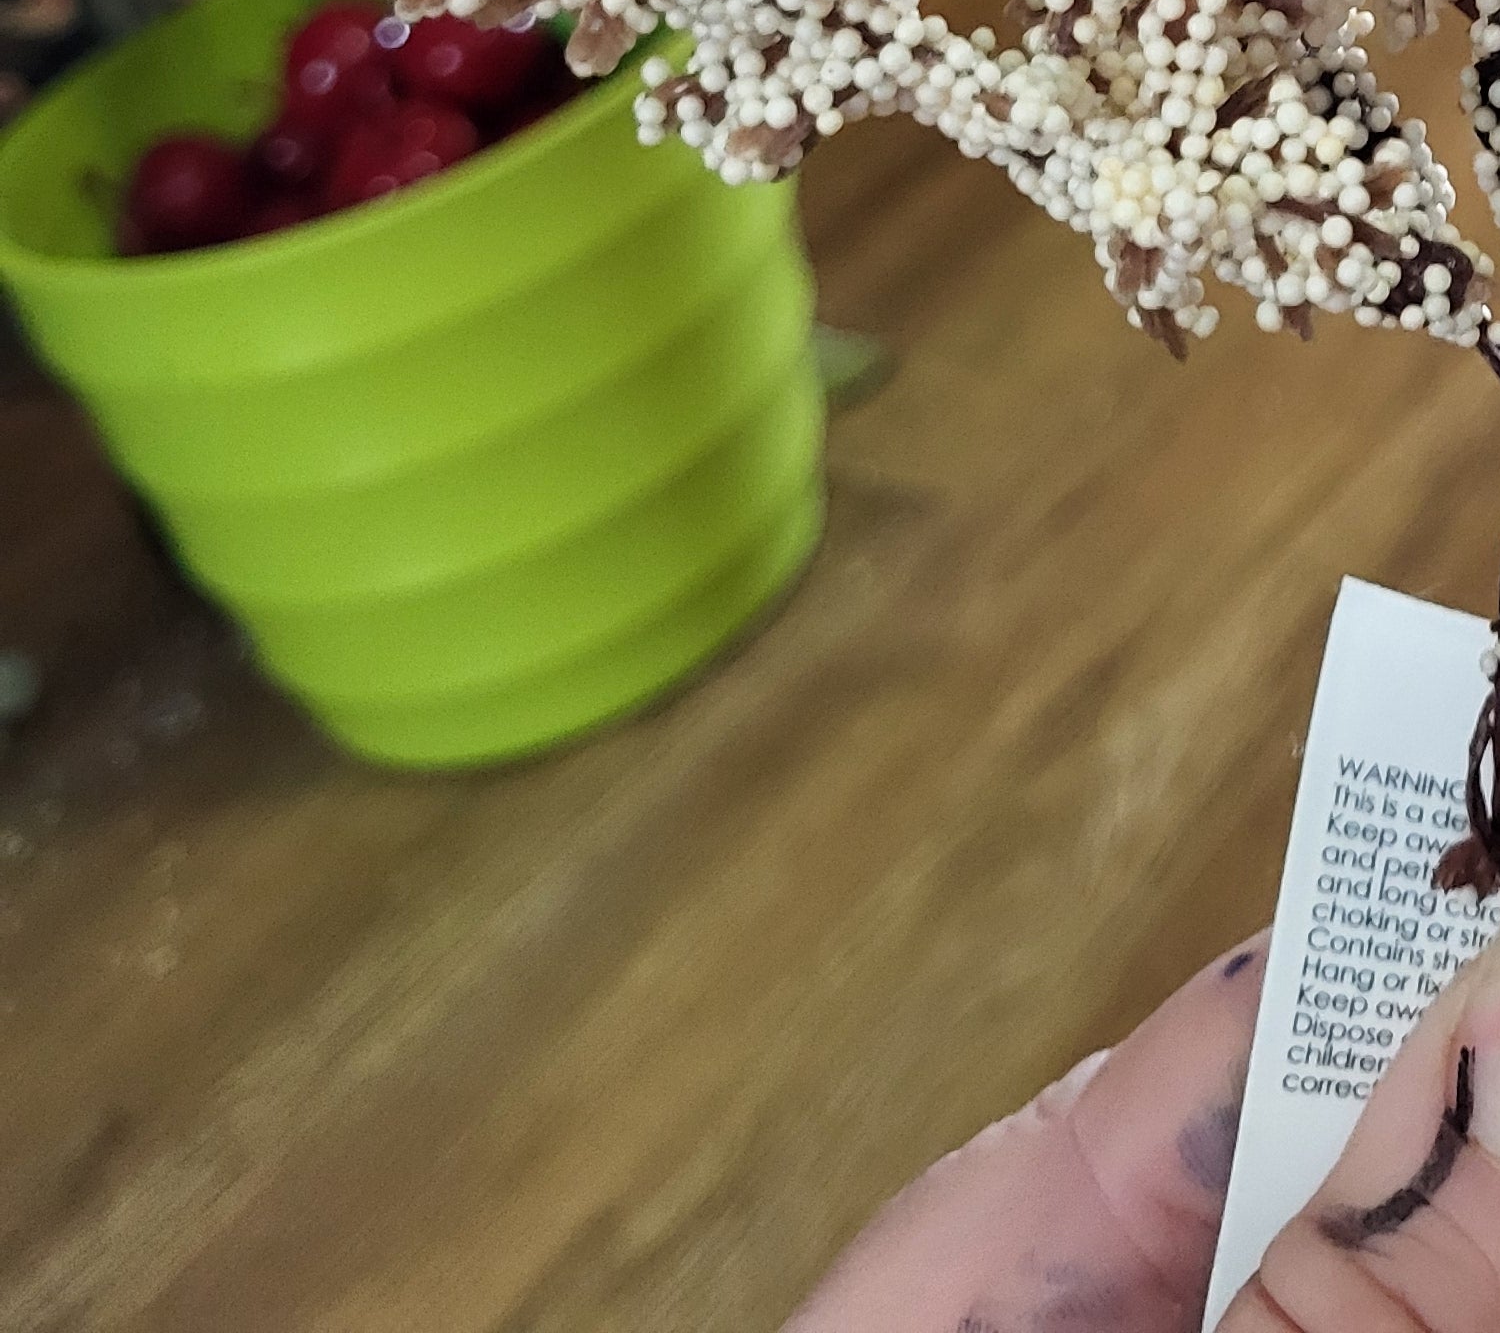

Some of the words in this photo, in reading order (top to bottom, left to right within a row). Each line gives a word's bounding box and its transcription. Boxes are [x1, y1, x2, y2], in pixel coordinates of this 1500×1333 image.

[1333, 782, 1374, 814] This
[1382, 793, 1397, 818] is
[1405, 803, 1424, 824] a
[1326, 811, 1398, 848] Keep
[1322, 844, 1378, 871] and
[1383, 856, 1429, 887] pet
[1317, 873, 1373, 899] and
[1378, 875, 1438, 917] long
[1312, 899, 1420, 942] choking
[1427, 921, 1454, 943] or
[1307, 925, 1425, 968] Contains
[1302, 955, 1376, 993] Hang
[1382, 972, 1411, 992] or
[1297, 983, 1368, 1018] Keep
[1292, 1011, 1394, 1047] Dispose
